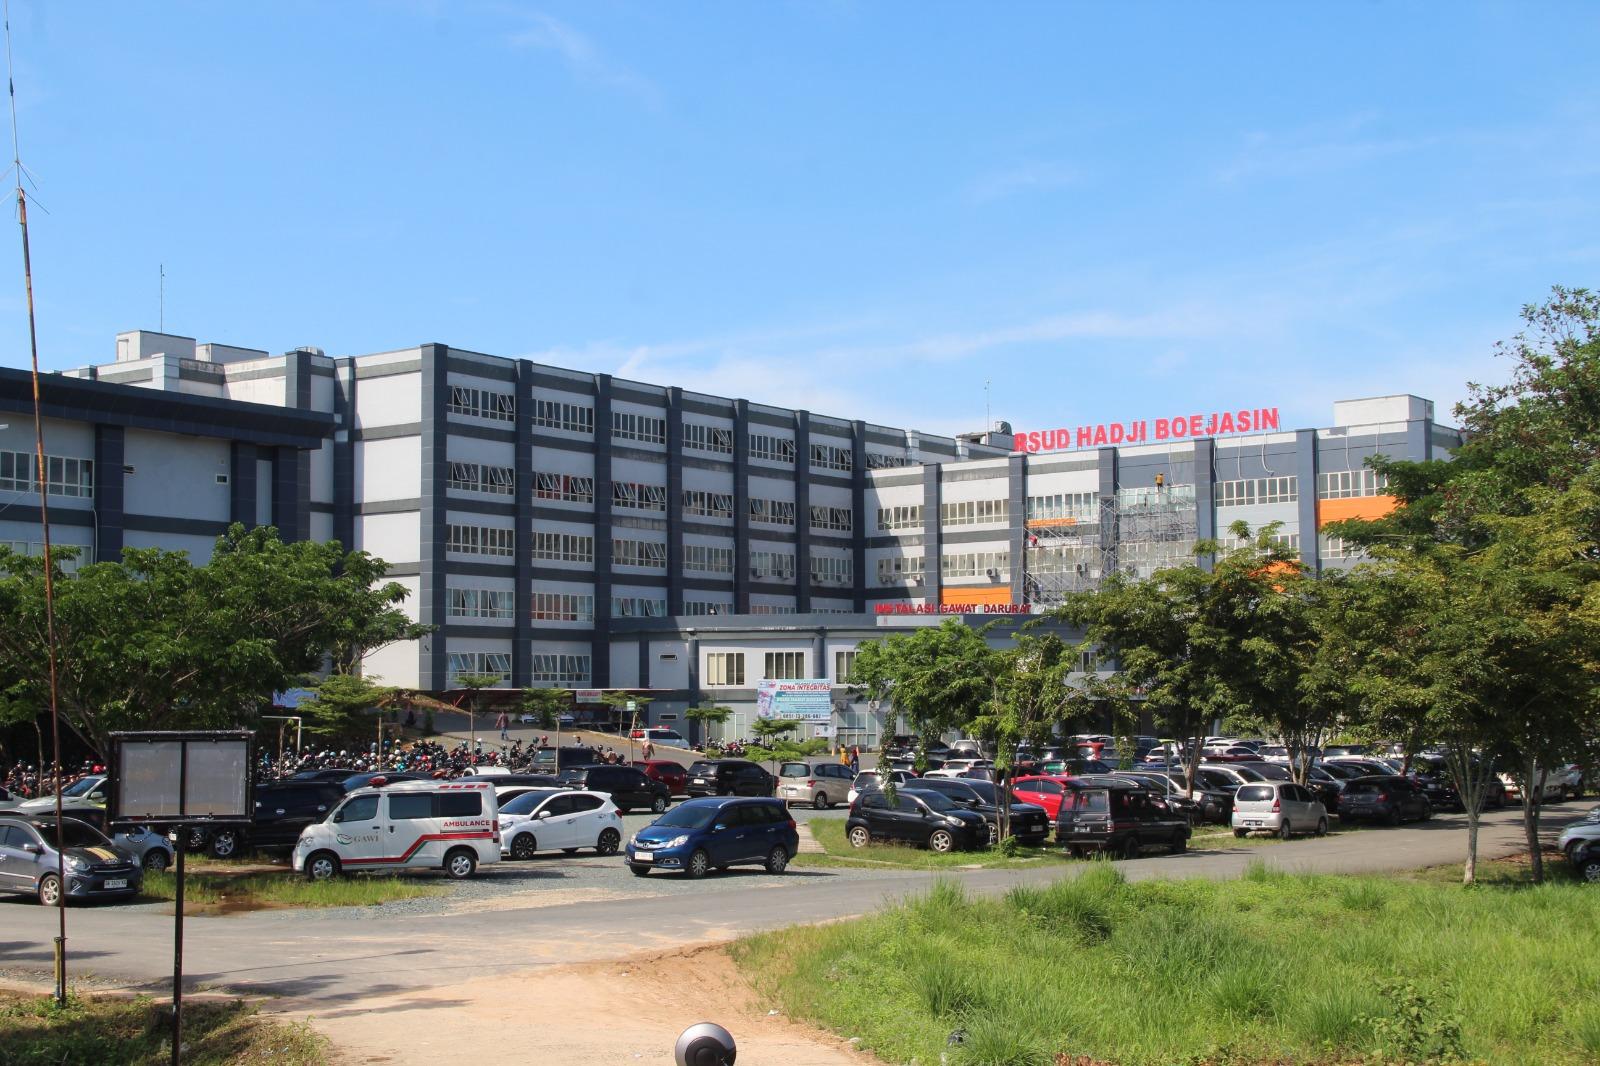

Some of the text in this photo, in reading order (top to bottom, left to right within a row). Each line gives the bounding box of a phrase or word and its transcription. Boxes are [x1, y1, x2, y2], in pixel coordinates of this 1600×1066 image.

[1014, 407, 1279, 454] RSUD HADJI BOEJASIN
[941, 603, 978, 614] GAWAT
[983, 603, 1032, 614] DARURAT
[443, 819, 491, 828] AMBULANCE
